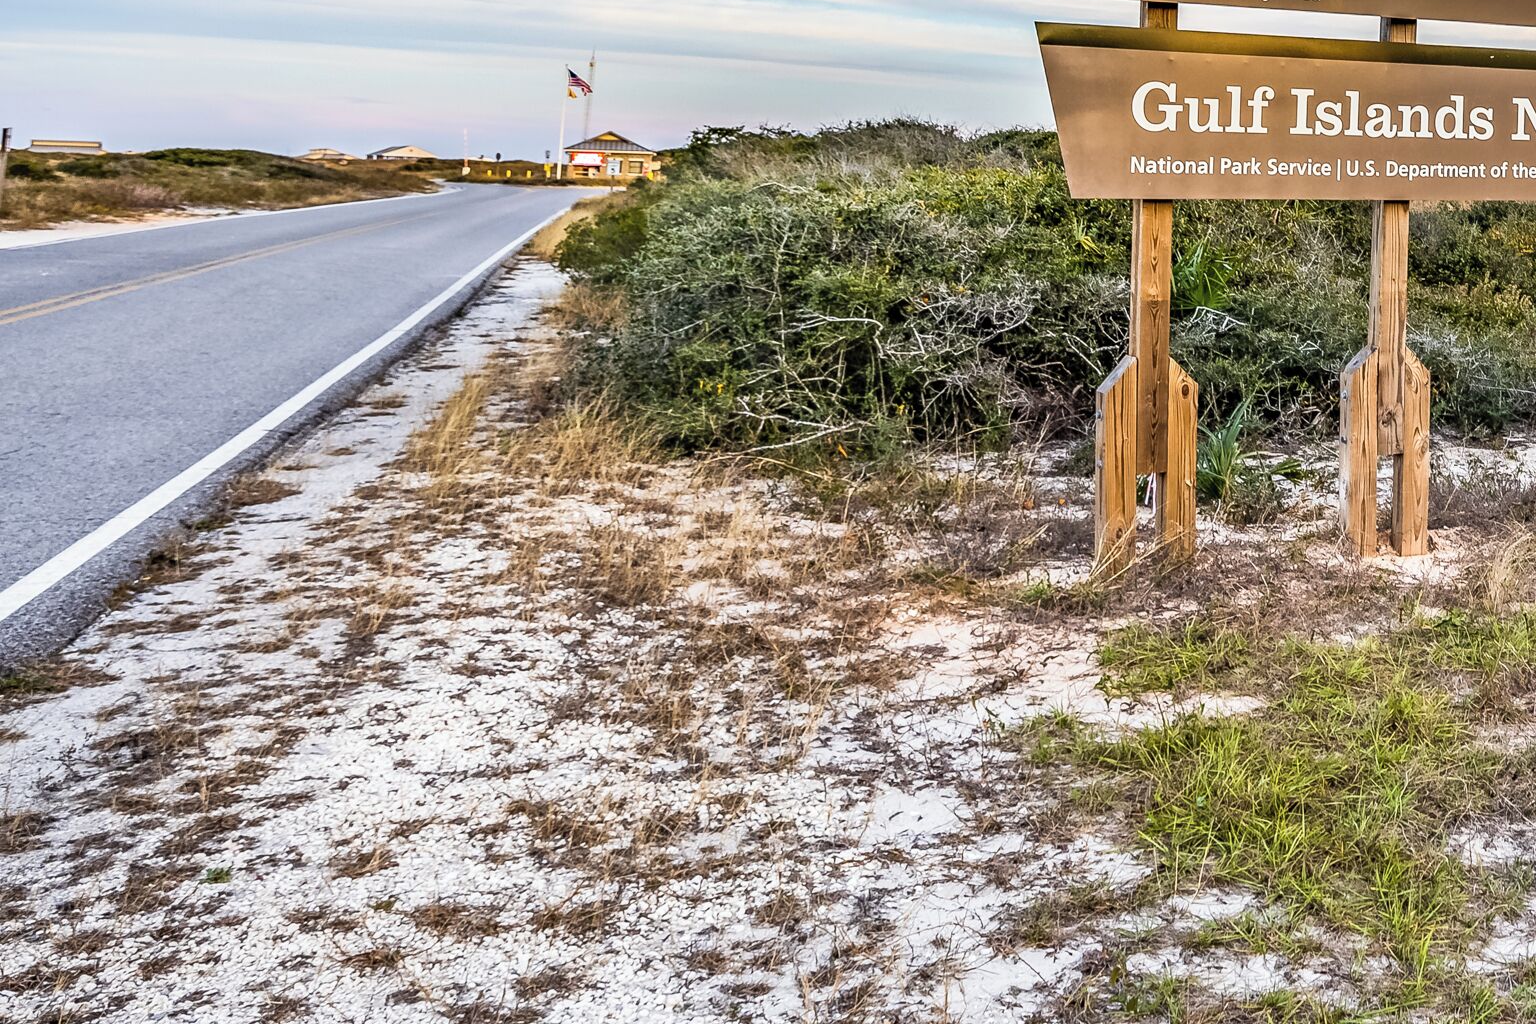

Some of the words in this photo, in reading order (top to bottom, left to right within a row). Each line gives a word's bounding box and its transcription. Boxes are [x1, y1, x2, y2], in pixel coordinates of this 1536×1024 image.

[1131, 81, 1275, 134] Gulf
[1289, 88, 1494, 141] Islands
[1130, 156, 1214, 175] National
[1220, 157, 1262, 175] Park
[1267, 158, 1332, 176] Service
[1346, 160, 1380, 177] U.S.
[1385, 160, 1486, 181] Department
[1490, 161, 1509, 178] of
